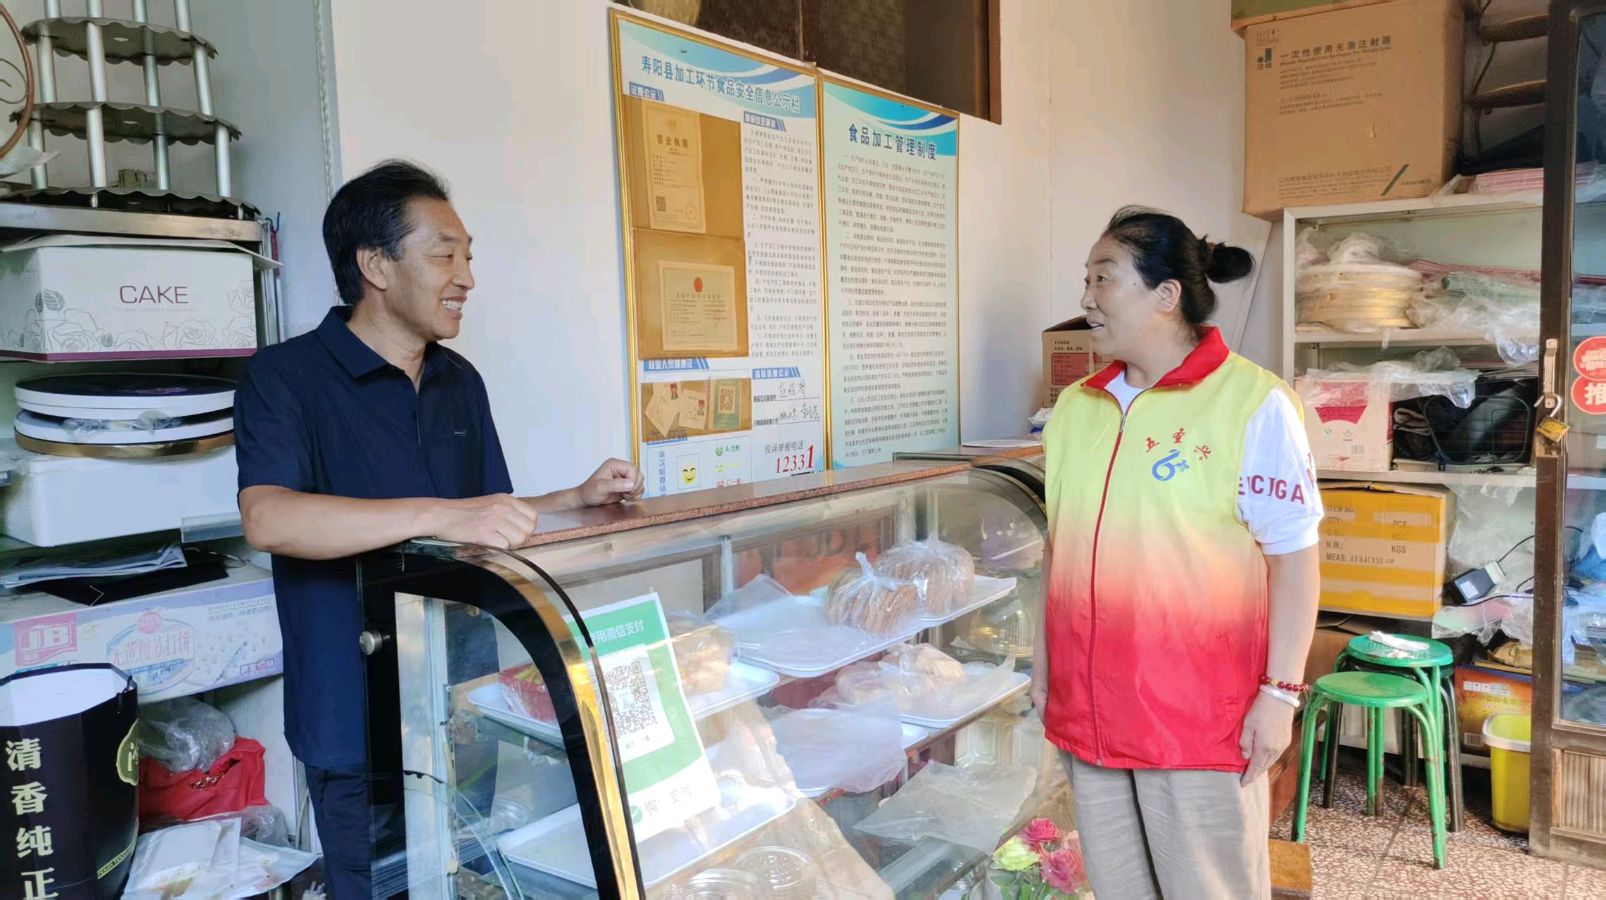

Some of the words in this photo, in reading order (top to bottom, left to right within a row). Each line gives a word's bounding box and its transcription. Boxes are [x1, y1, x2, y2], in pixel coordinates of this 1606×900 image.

[1280, 35, 1391, 59] 一次性使用无菌注射器
[641, 55, 800, 113] 寿阳县加工环节食品安全信息公示栏
[848, 123, 936, 161] 食品加工管理制度
[119, 285, 189, 304] CAKE
[765, 440, 804, 454] 投诉举报电话
[775, 444, 815, 474] 12331
[1391, 545, 1408, 554] KGS
[644, 784, 692, 817] 微支付
[5, 737, 59, 900] 清香纯正
